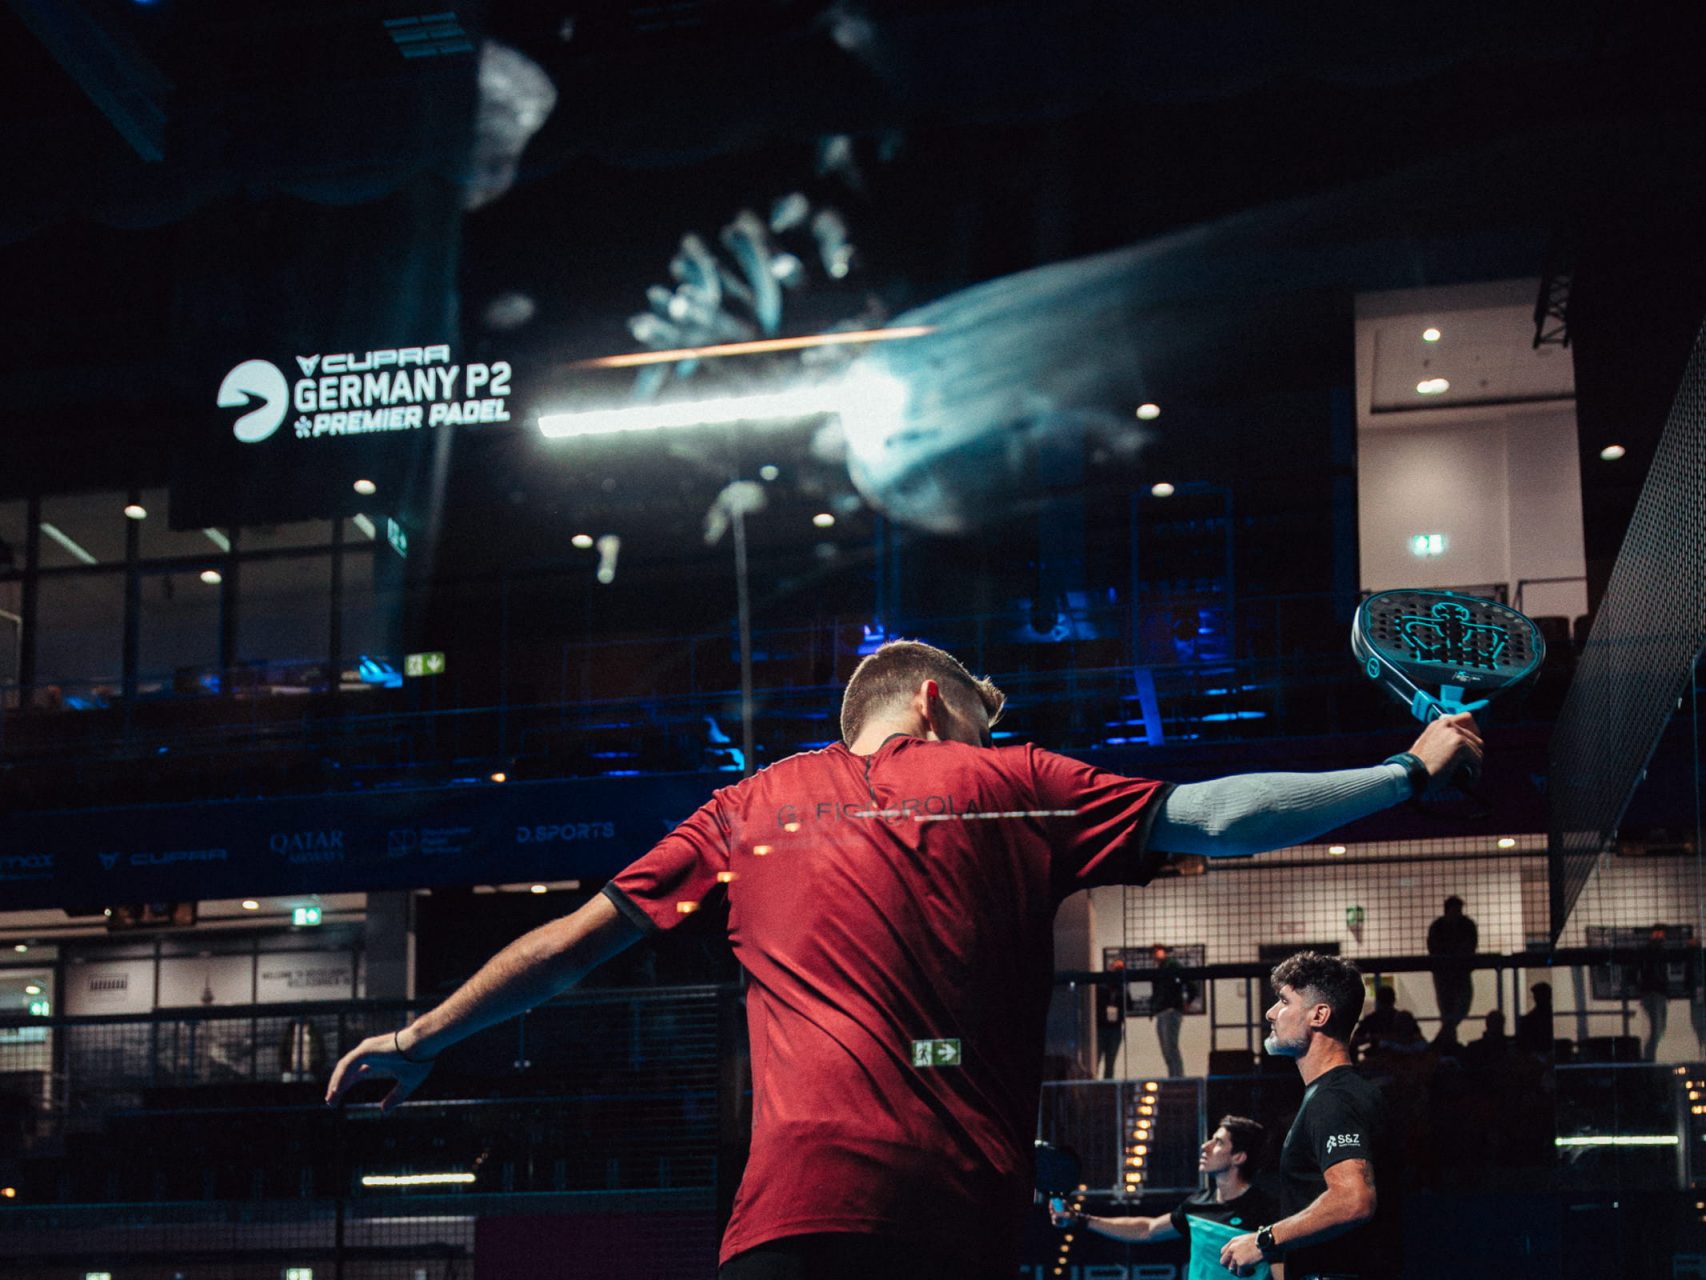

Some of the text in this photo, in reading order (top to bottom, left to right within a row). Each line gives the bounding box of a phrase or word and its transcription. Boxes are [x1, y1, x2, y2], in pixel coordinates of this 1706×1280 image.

[321, 344, 450, 374] CUPRA
[294, 361, 512, 413] GERMANY P2
[312, 398, 511, 437] PREMIER PADEL
[270, 829, 345, 855] QATAR
[515, 821, 616, 844] D.SPORTS
